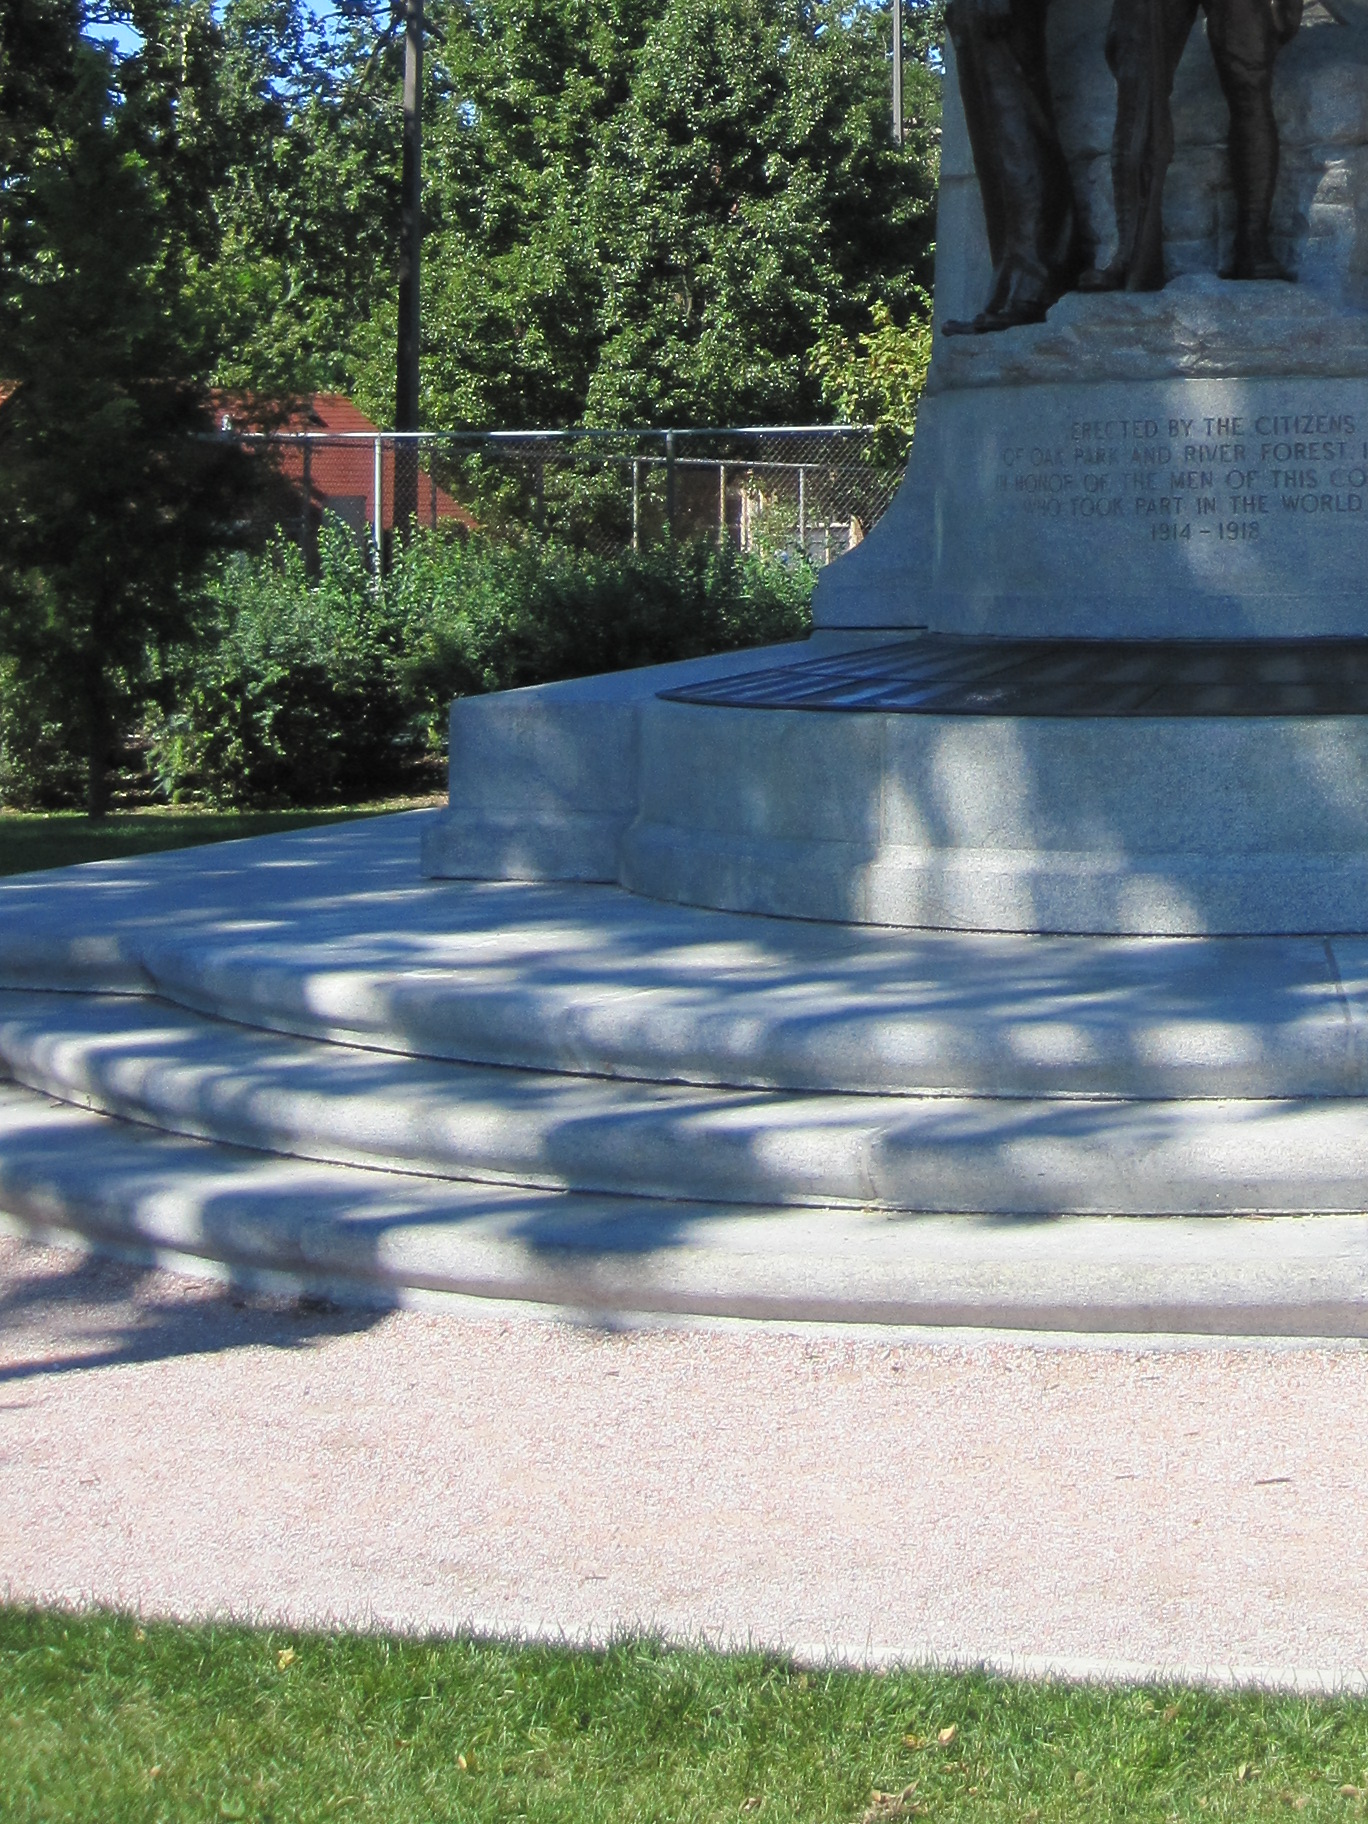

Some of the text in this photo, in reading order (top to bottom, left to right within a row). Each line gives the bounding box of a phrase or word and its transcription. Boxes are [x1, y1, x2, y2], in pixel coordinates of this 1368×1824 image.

[1072, 414, 1356, 440] ERECTED BY THE CITIZENS
[1003, 447, 1024, 467] OF
[1030, 447, 1065, 467] OAK
[1074, 447, 1120, 466] PARK
[1130, 445, 1172, 465] AND
[1184, 443, 1246, 463] RIVER
[1083, 473, 1109, 493] OF
[1123, 472, 1158, 491] THE
[1170, 470, 1213, 490] MEN
[1225, 469, 1259, 490] OF
[1270, 468, 1318, 489] THIS
[1070, 497, 1124, 517] TOOK
[1135, 496, 1184, 516] PART
[1196, 496, 1216, 515] IN
[1229, 494, 1269, 514] THE
[1281, 493, 1363, 514] WORLD
[1151, 522, 1191, 541] 1914
[1218, 520, 1260, 541] 1918
